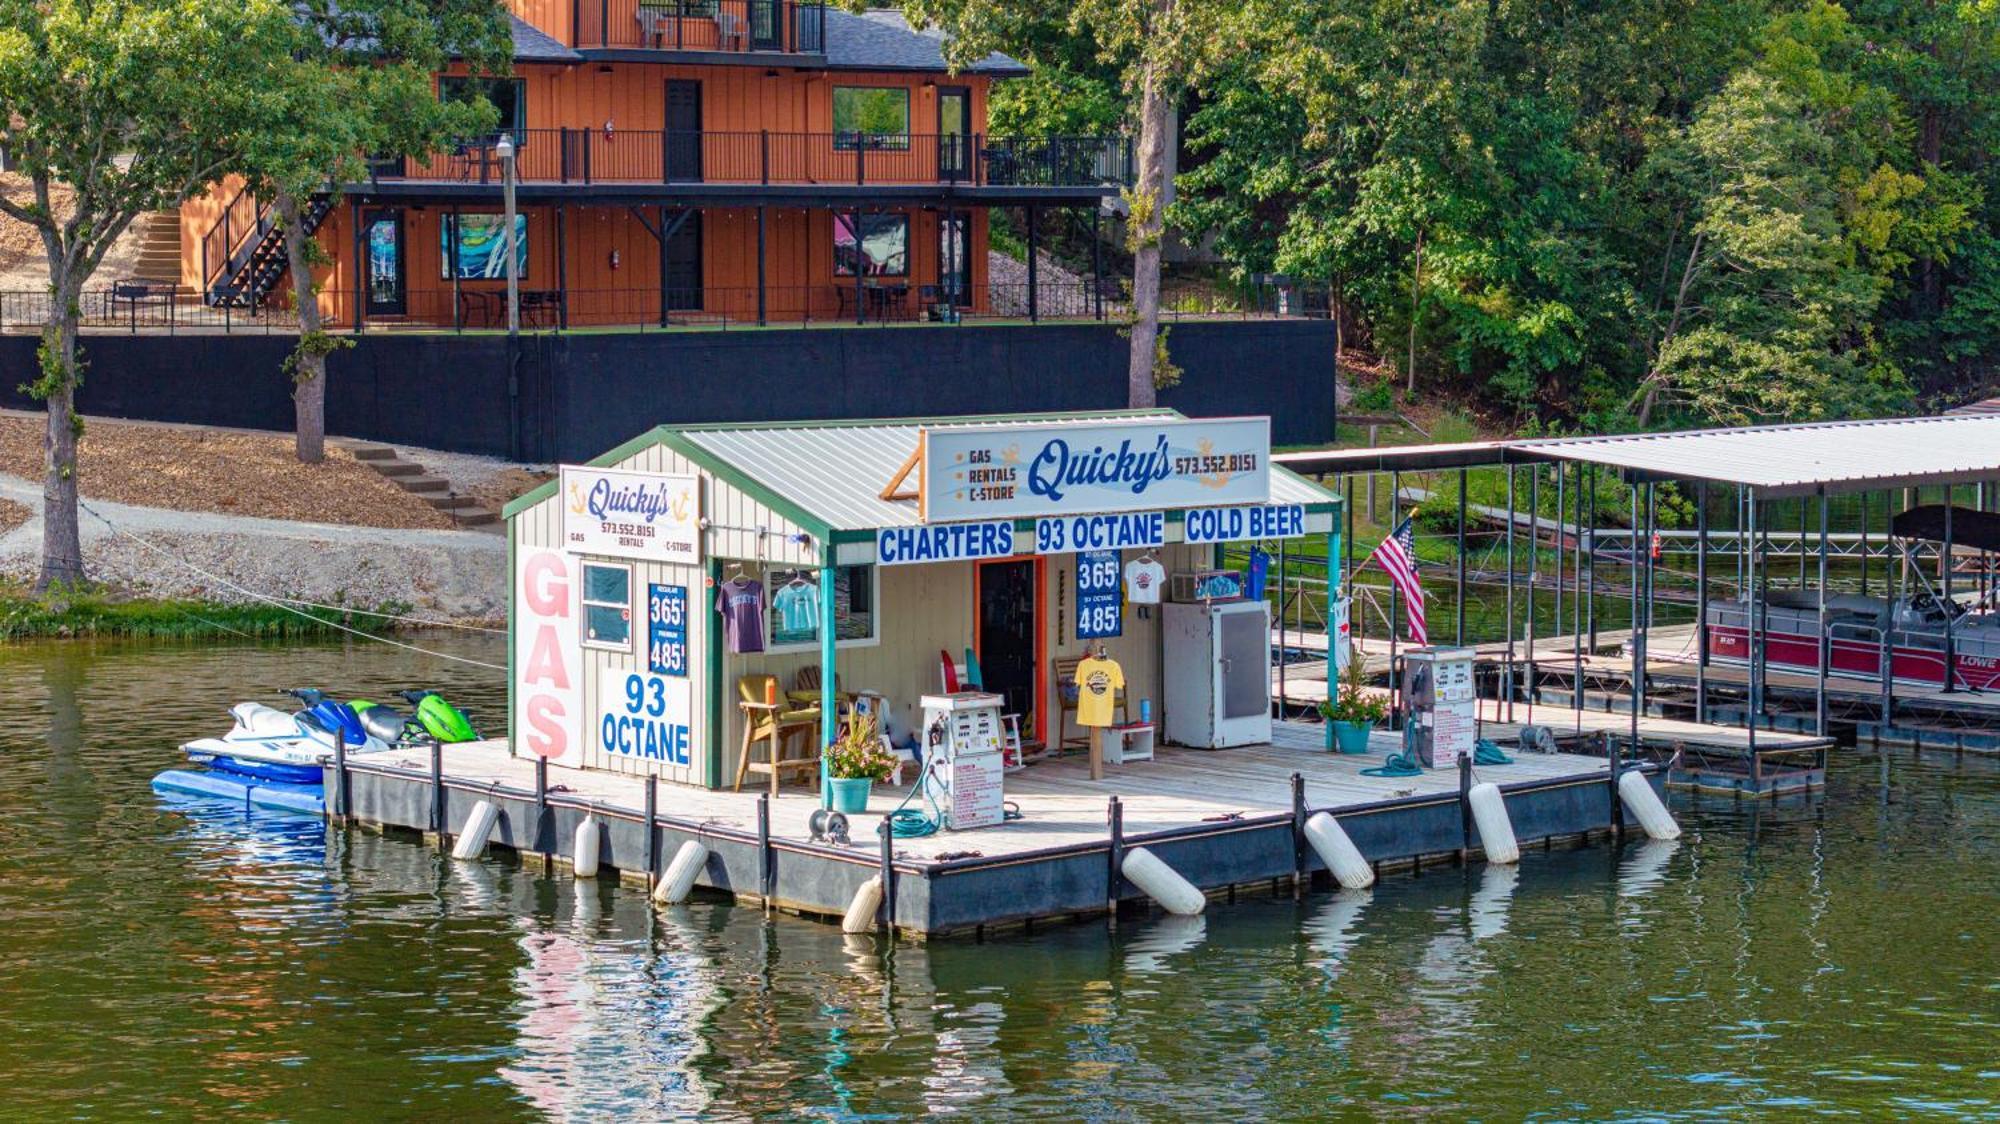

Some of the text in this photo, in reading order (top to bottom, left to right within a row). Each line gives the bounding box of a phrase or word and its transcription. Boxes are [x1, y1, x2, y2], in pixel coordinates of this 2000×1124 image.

[969, 450, 991, 464] GAS
[1028, 434, 1172, 501] Quicky's
[1175, 454, 1257, 475] 573.552.8151
[969, 468, 1016, 483] RENTALS
[588, 478, 669, 523] Quicky's
[969, 487, 1014, 501] C-STORE
[601, 522, 656, 538] 573.552.8151
[1038, 513, 1164, 551] 93 OCTANE
[1187, 505, 1304, 541] COLD BEER
[570, 533, 693, 553] GAS RENTALS C-STORE
[879, 522, 1013, 562] CHARTERS
[524, 552, 571, 759] GAS
[1960, 655, 1997, 668] LOWE
[626, 674, 666, 718] 93
[602, 713, 689, 765] OCTANE
